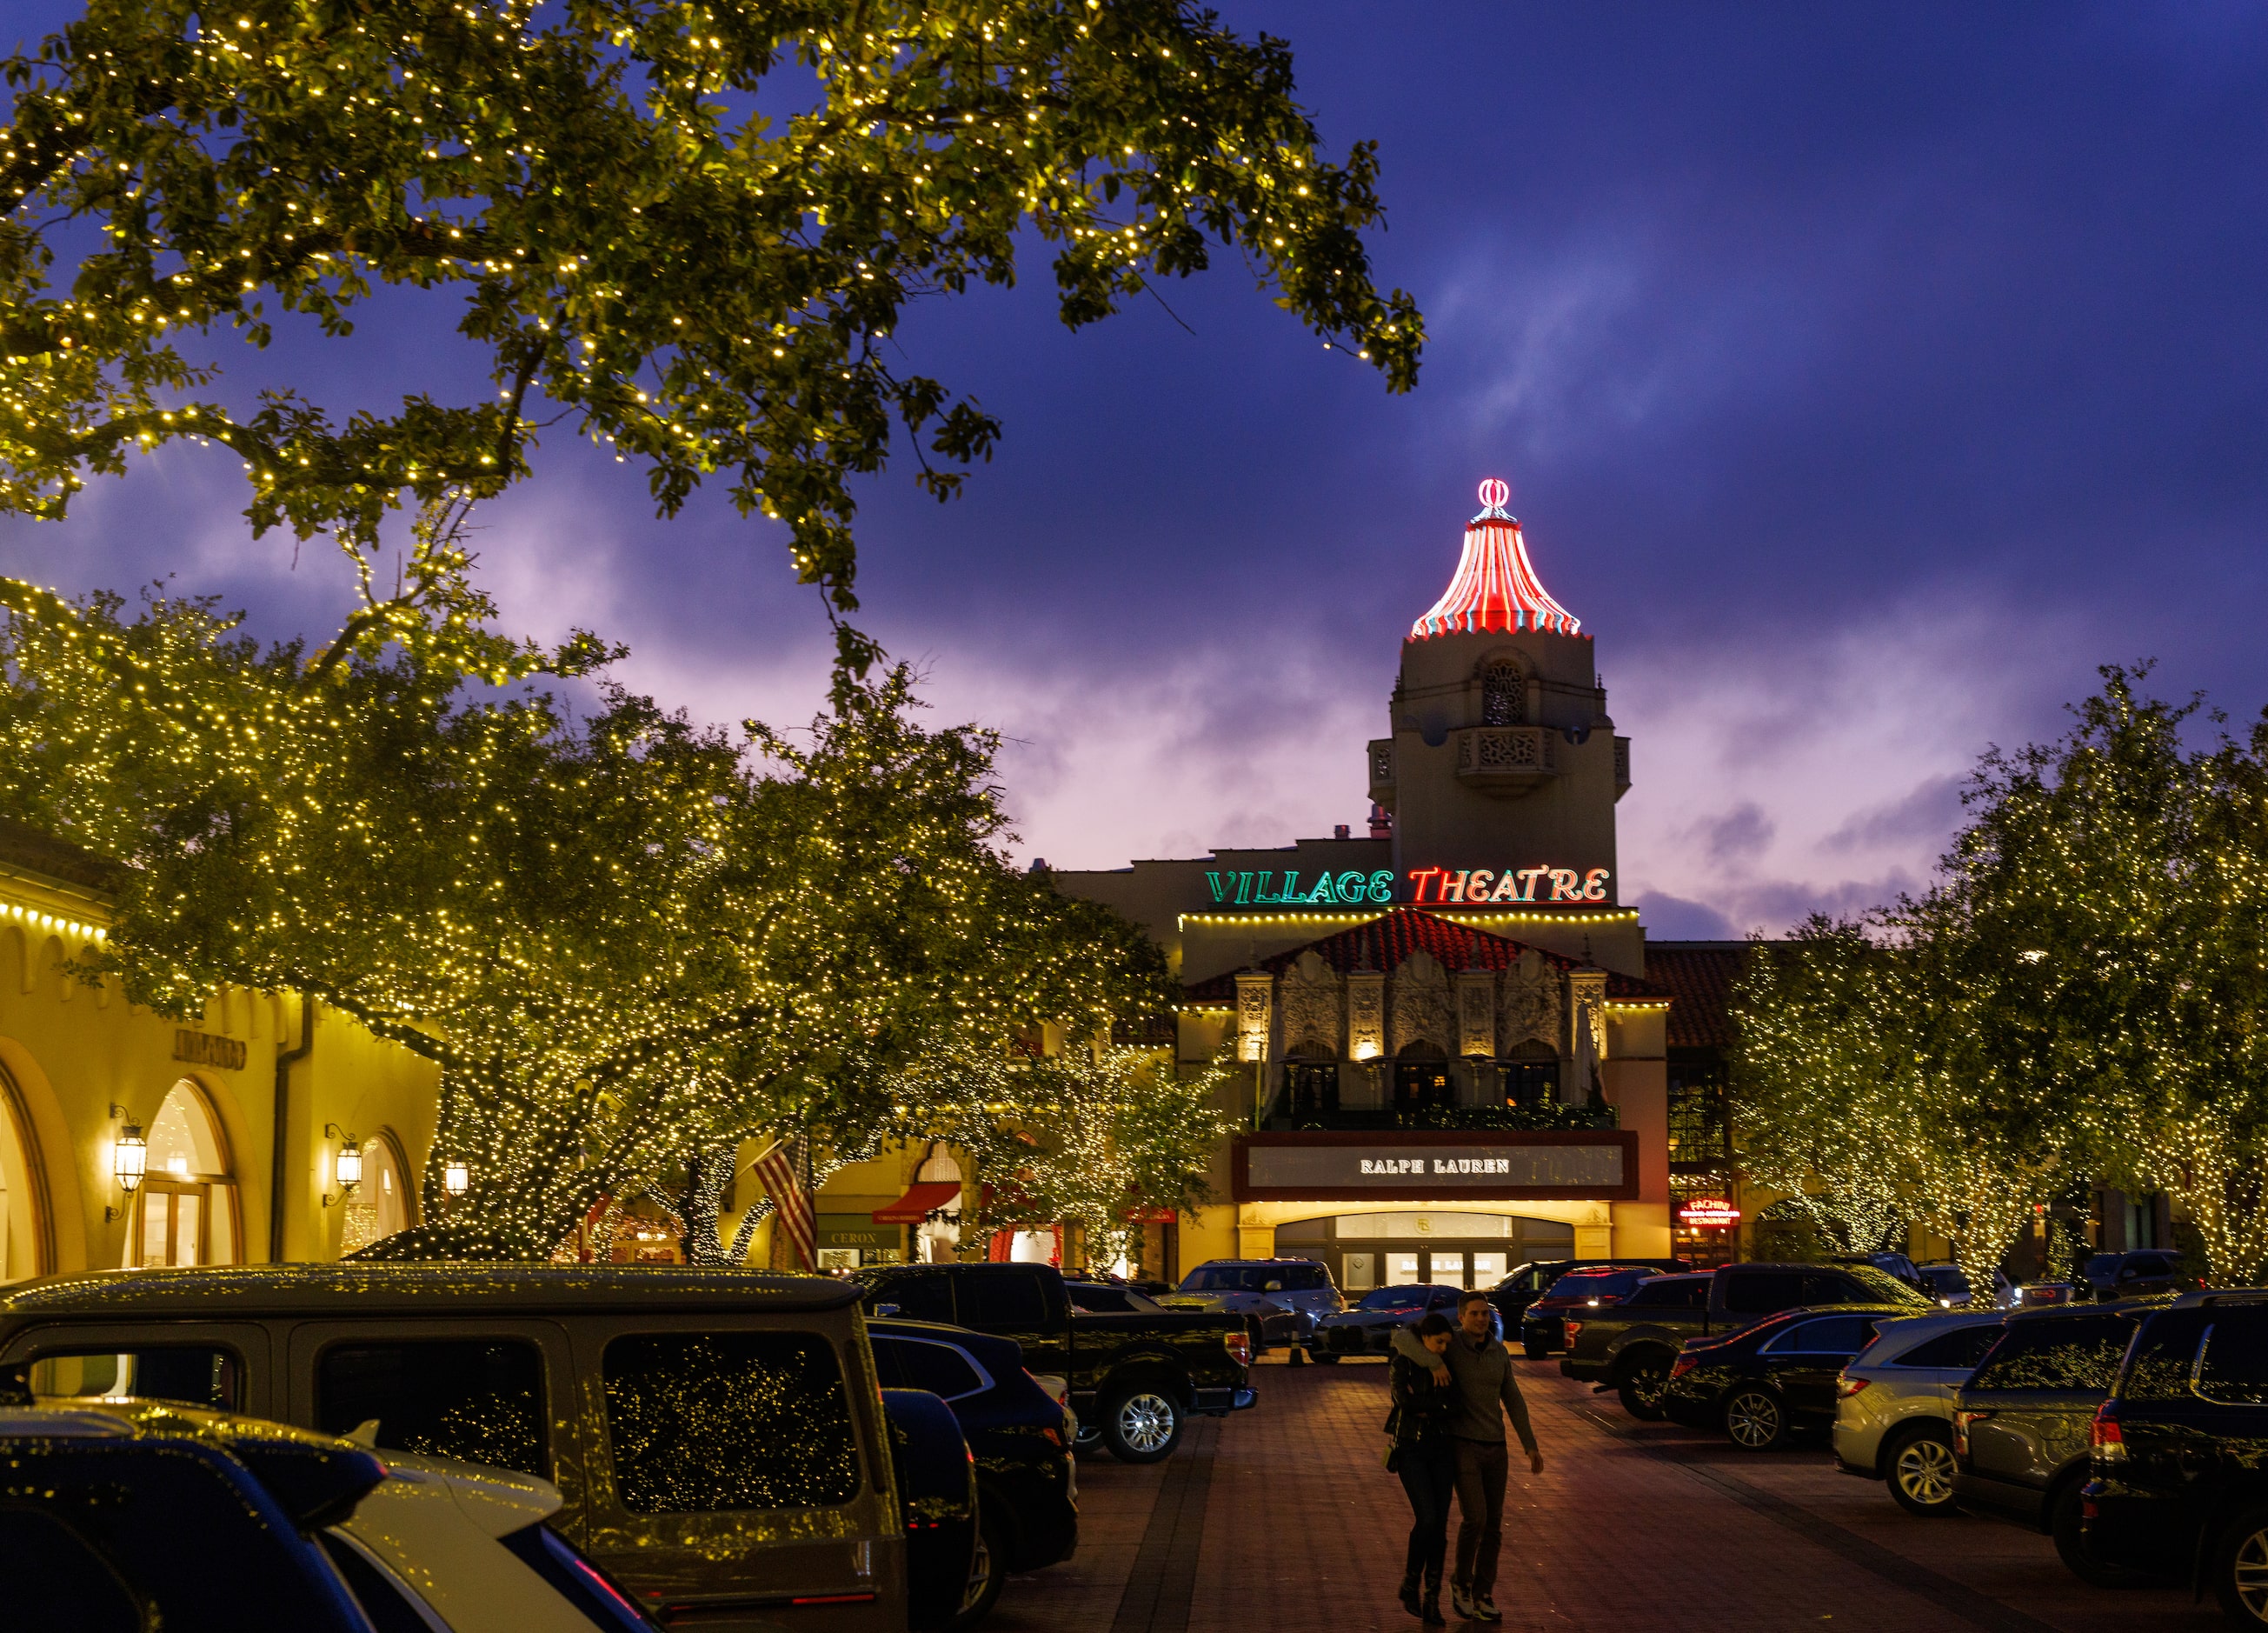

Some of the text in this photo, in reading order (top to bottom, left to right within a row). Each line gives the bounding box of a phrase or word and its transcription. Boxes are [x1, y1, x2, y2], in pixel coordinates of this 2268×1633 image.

[1205, 863, 1611, 904] VILLAGE THEATRE
[1360, 1158, 1510, 1174] RALPH LAUREN
